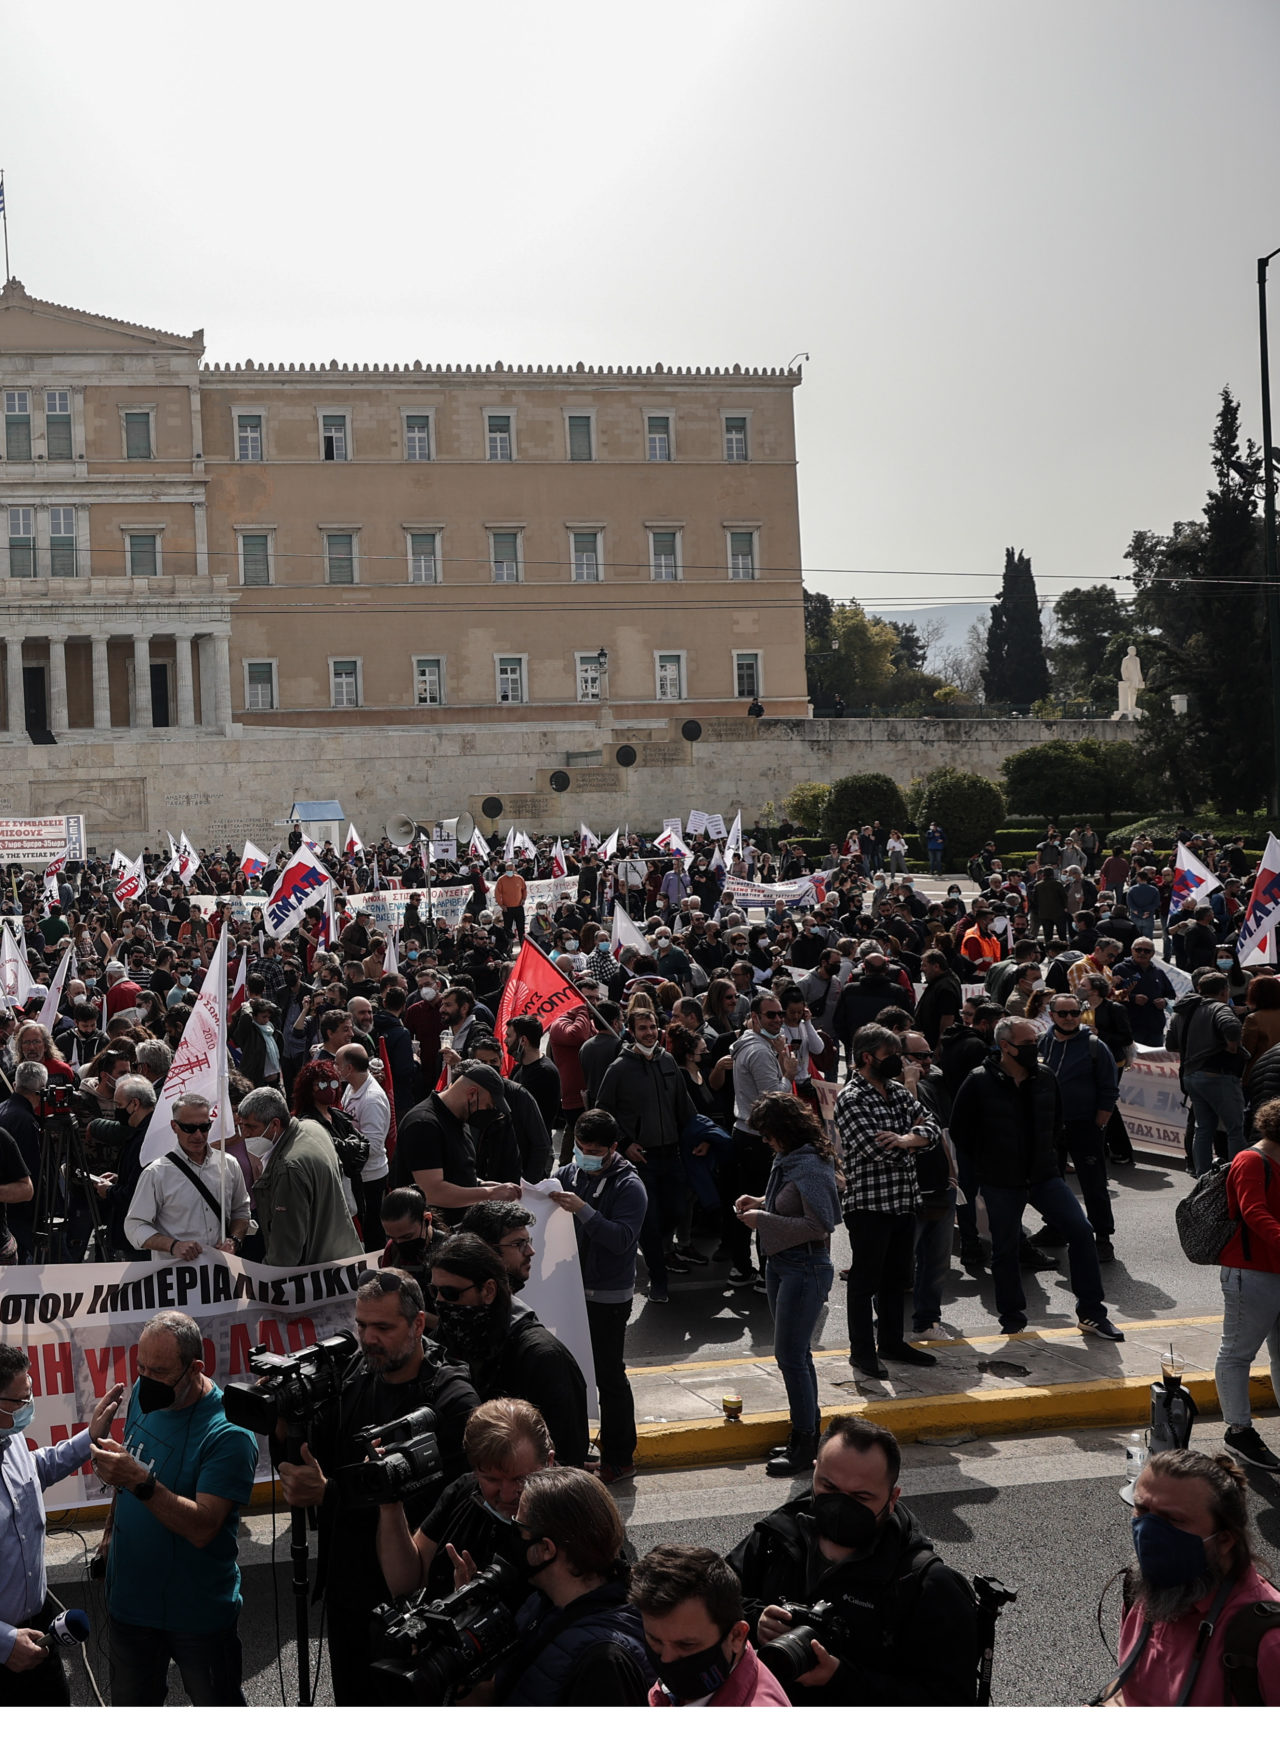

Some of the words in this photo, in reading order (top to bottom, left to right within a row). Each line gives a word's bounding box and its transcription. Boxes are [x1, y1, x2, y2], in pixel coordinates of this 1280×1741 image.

[12, 818, 64, 827] ΣΥΜΒΑΣΕΙΣ
[202, 1027, 216, 1050] 2010
[0, 1292, 84, 1325] στον
